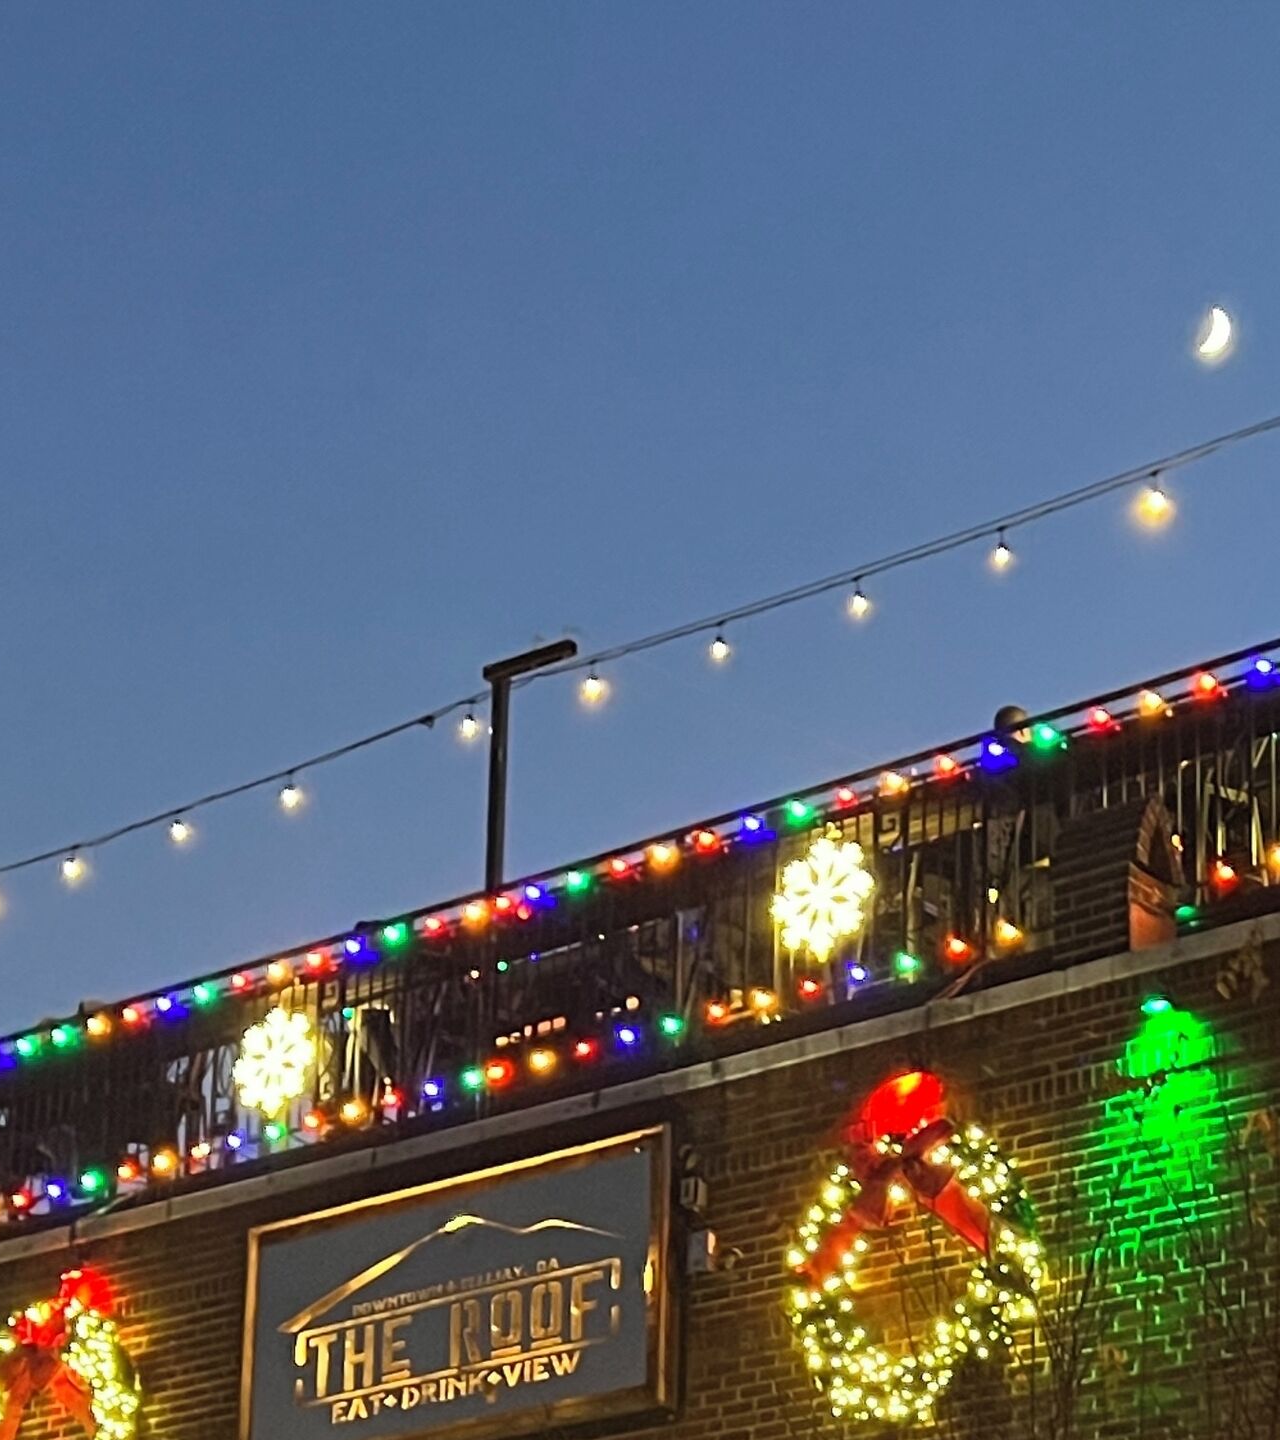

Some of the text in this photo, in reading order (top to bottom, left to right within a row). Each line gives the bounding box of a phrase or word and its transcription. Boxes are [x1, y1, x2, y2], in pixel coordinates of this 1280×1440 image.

[308, 1270, 605, 1398] THE ROOF
[331, 1350, 583, 1425] EAT DRINK VIEW
